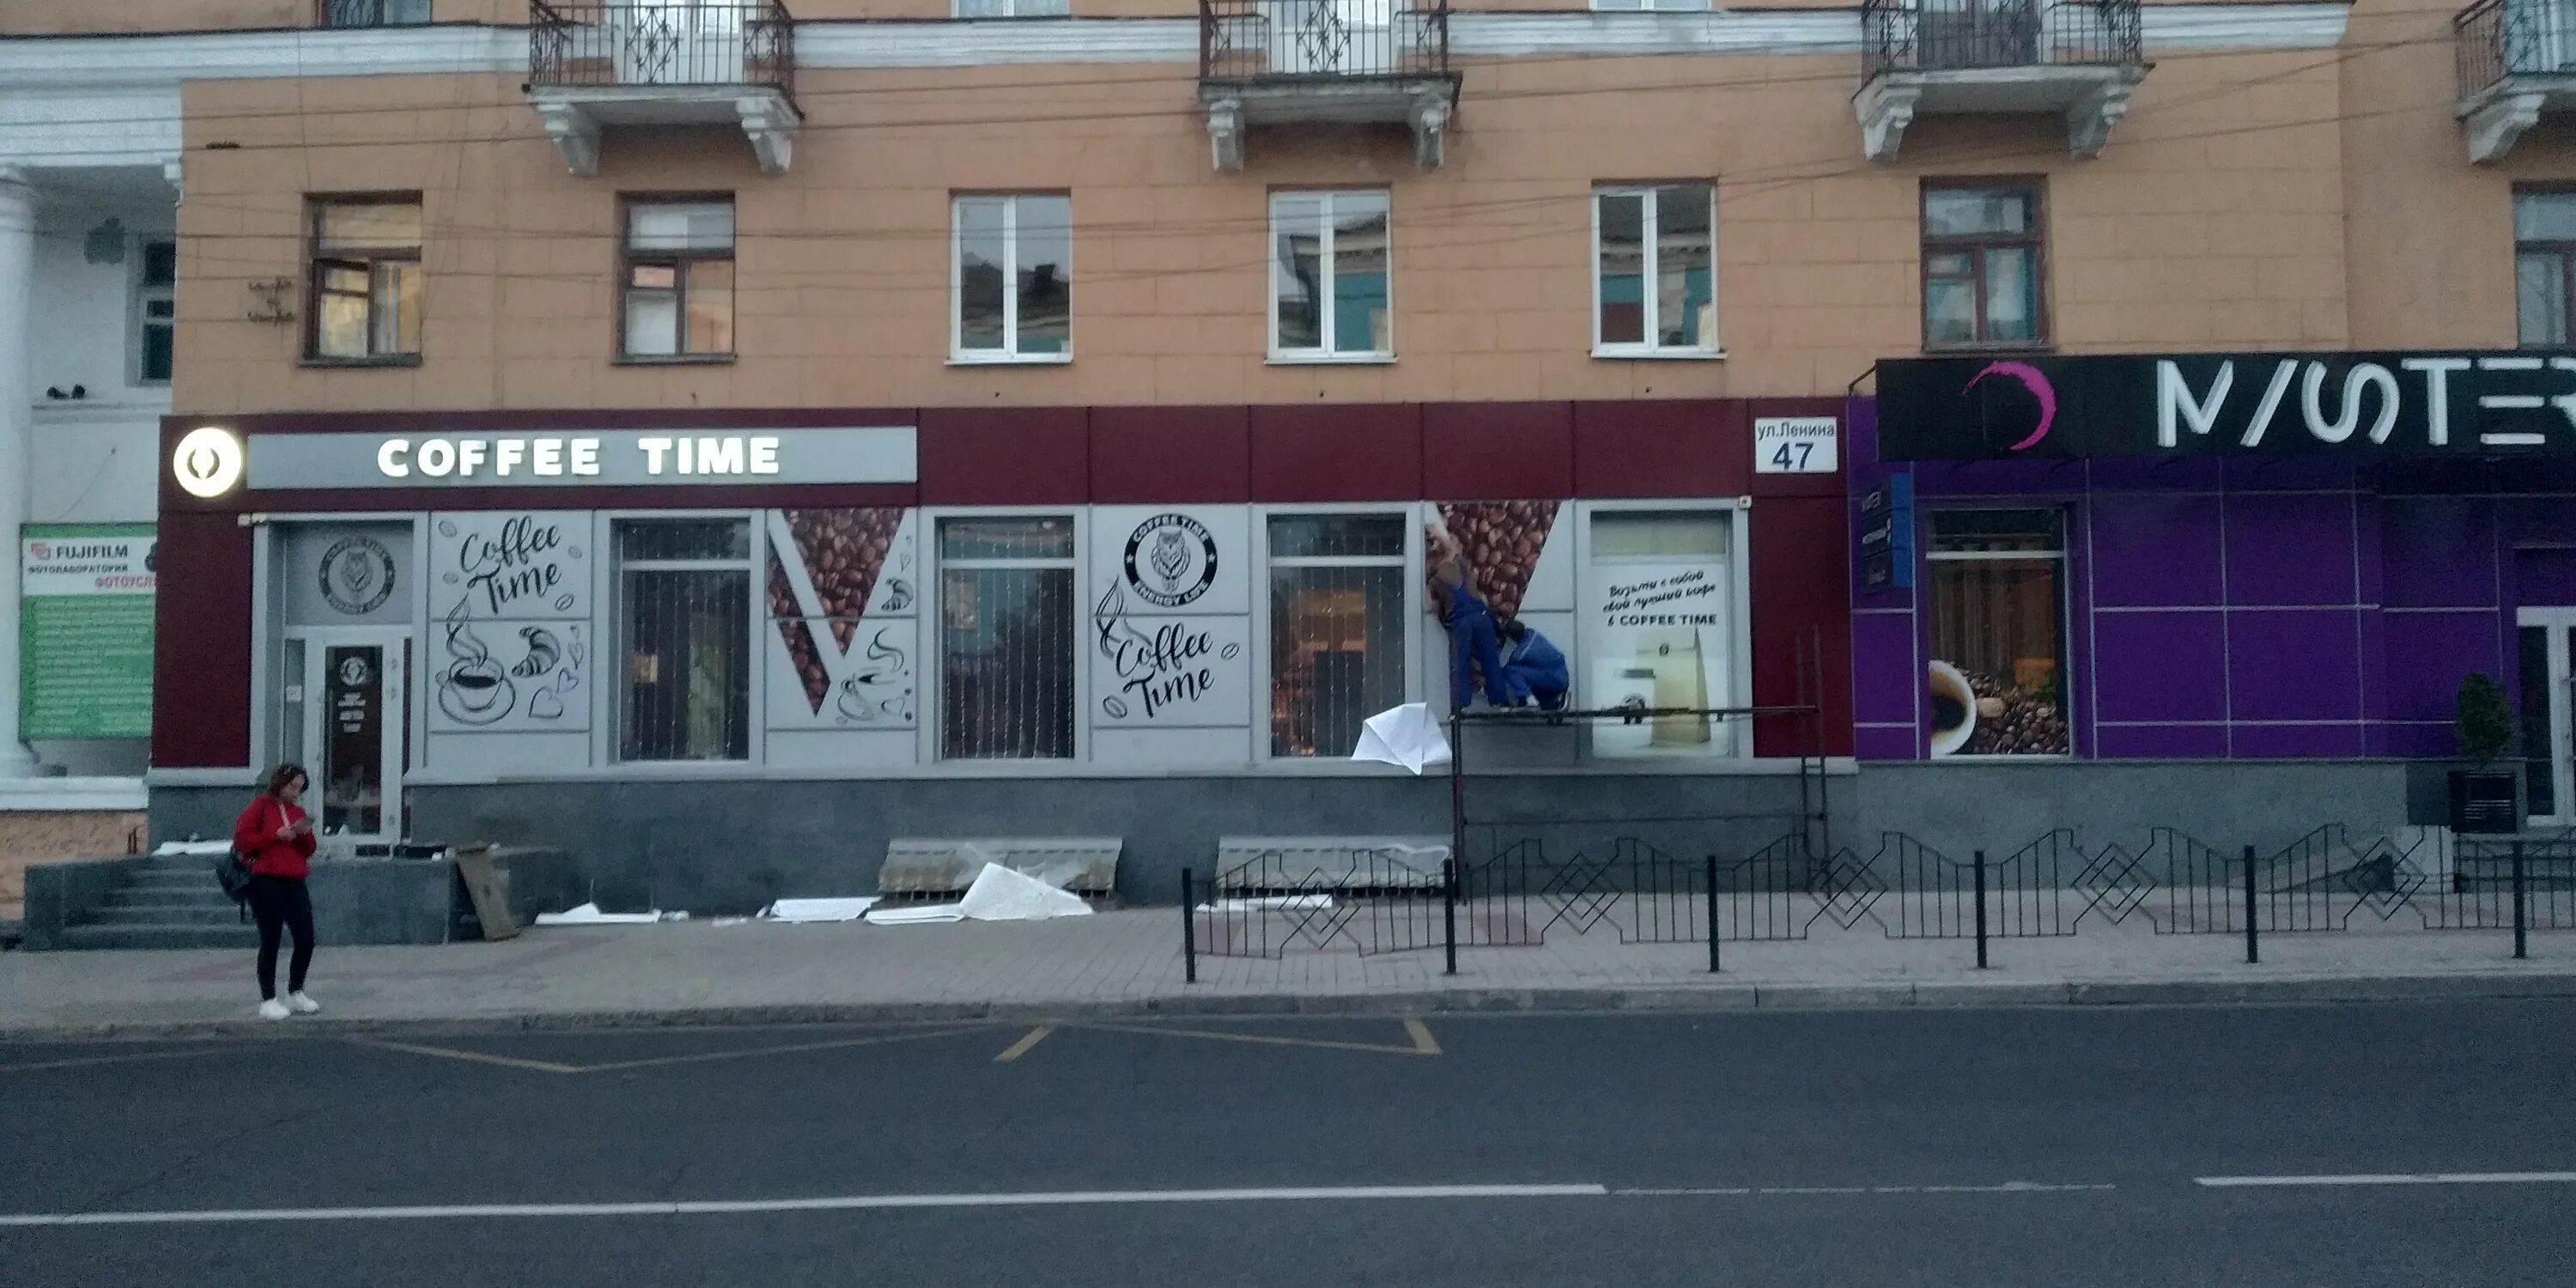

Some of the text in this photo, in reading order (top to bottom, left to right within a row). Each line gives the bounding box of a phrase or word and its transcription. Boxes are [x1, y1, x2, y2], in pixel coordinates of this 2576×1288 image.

[1759, 422, 1834, 441] ул.Ленина
[377, 436, 780, 477] COFFEE TIME
[1772, 441, 1814, 470] 47
[56, 544, 129, 558] FUJIFILM
[460, 515, 562, 573] Coffee
[27, 562, 129, 574] ФОТОЛАБОРАТОРИЯ
[467, 560, 562, 614] Time
[1619, 614, 1676, 626] COFFEE
[1679, 613, 1717, 626] TIME
[1115, 623, 1213, 677] Coffee
[1122, 665, 1215, 719] Time
